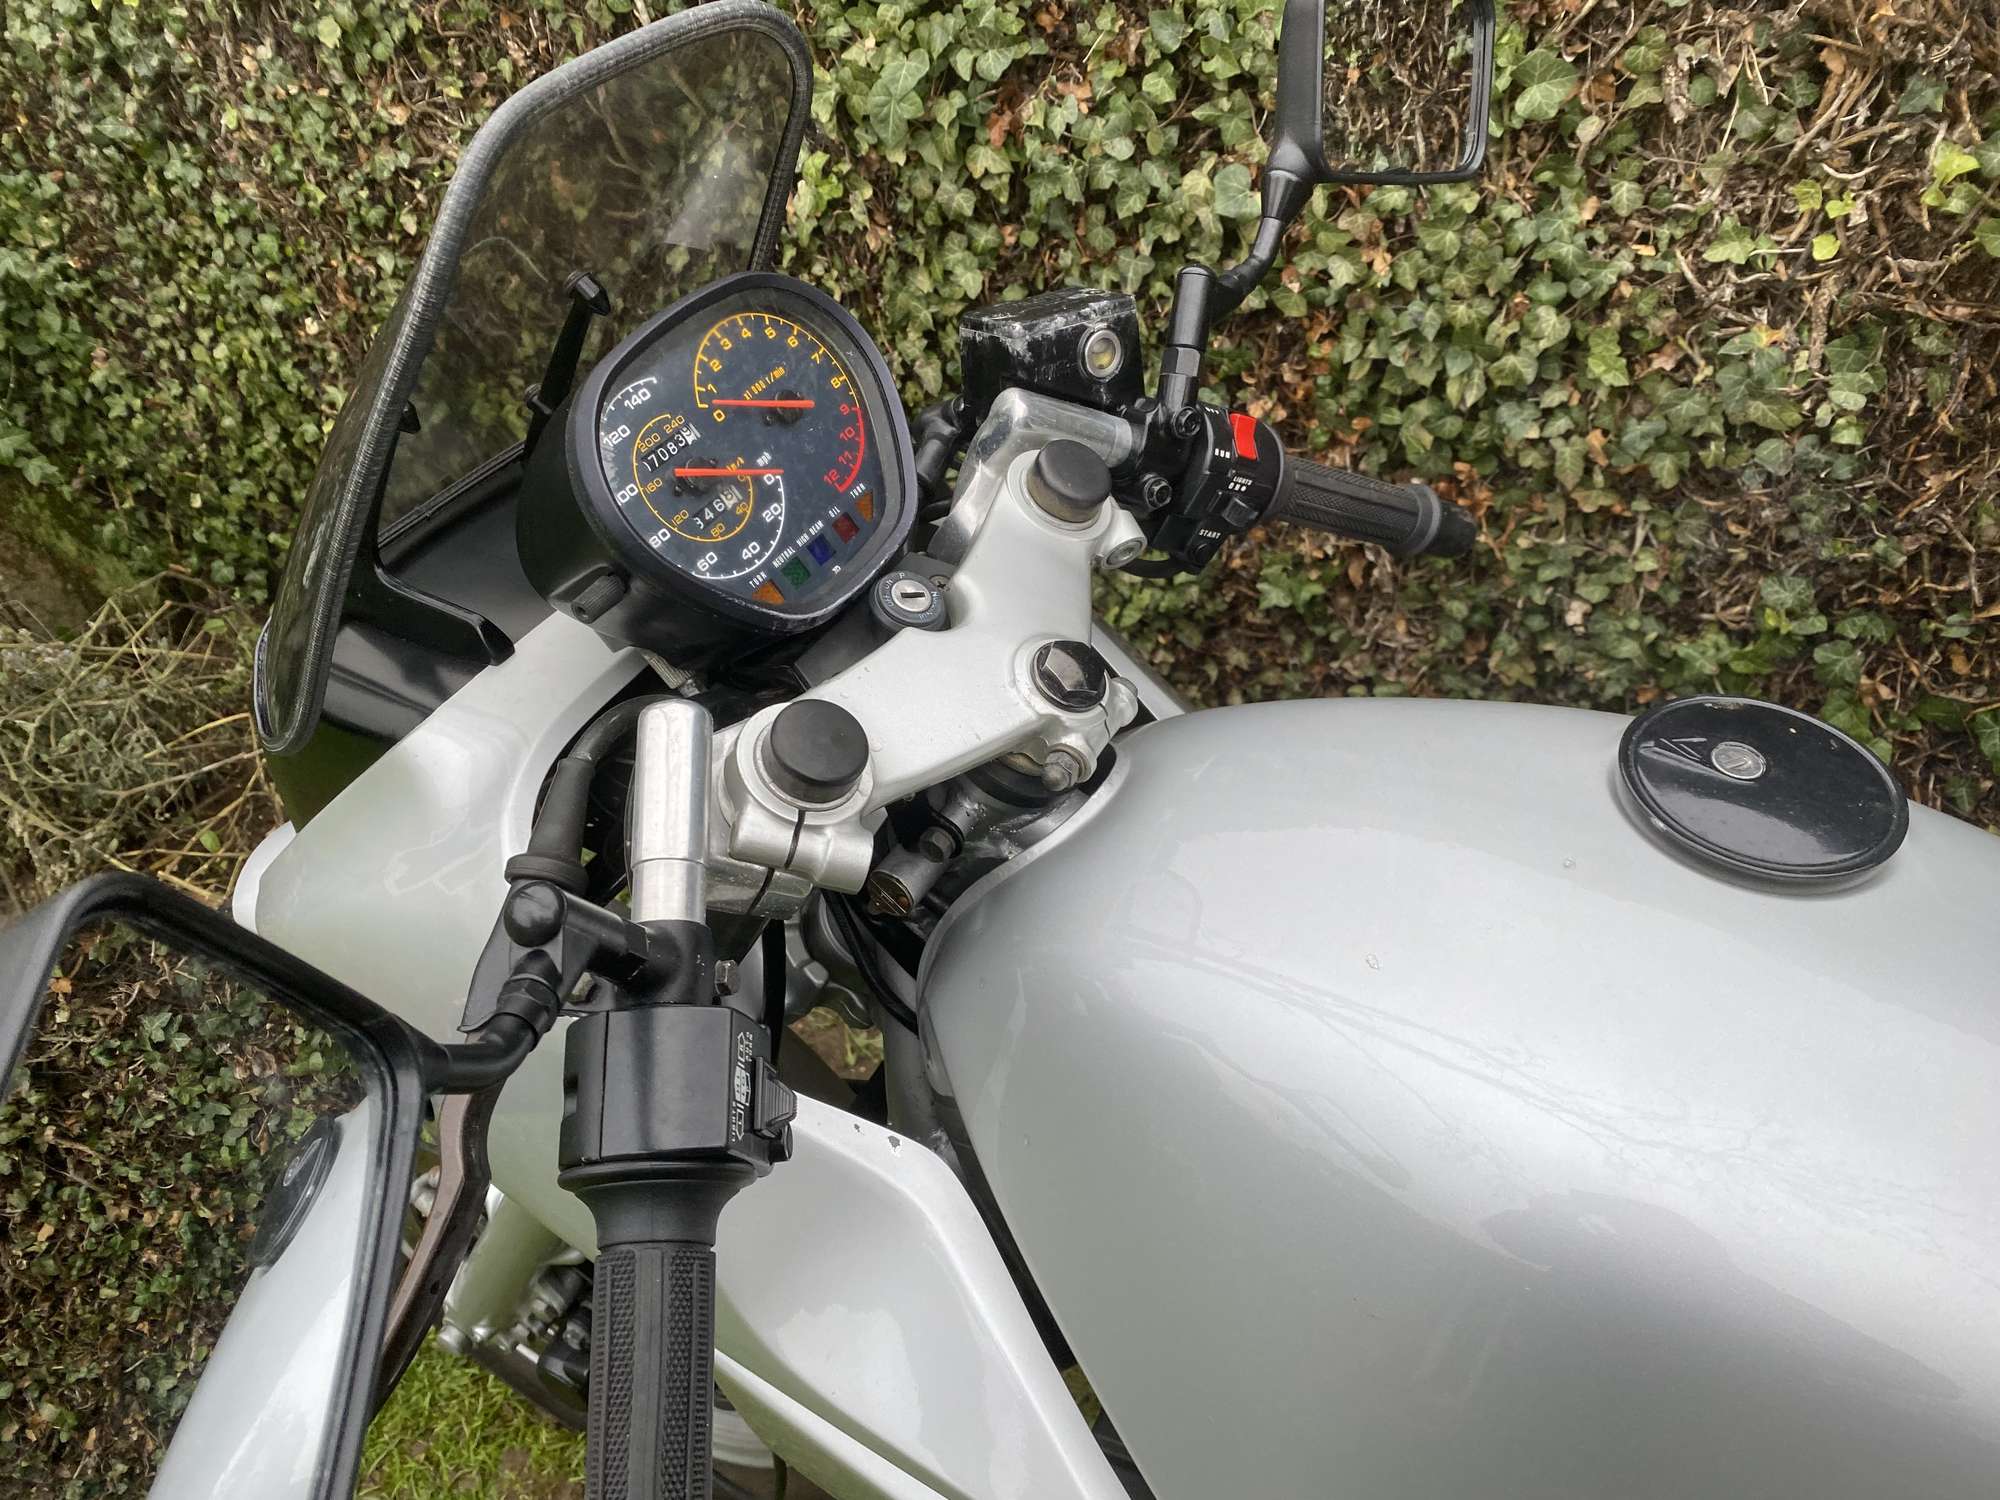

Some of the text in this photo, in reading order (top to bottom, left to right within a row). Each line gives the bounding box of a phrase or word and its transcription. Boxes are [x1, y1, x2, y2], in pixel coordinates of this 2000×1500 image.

[741, 328, 752, 338] 4
[764, 327, 776, 339] 5
[720, 338, 732, 350] 3
[787, 335, 799, 348] 6
[811, 352, 820, 364] 7
[710, 359, 722, 372] 2
[707, 383, 717, 393] 1
[831, 377, 841, 388] 8
[624, 388, 651, 410] 140
[713, 409, 726, 422] 0
[840, 404, 850, 415] 9
[663, 415, 685, 434] 240
[603, 424, 631, 447] 120
[839, 426, 856, 440] 10
[638, 432, 661, 453] 200
[838, 451, 853, 464] 11
[763, 473, 775, 485] 0
[823, 468, 840, 485] 12
[1233, 476, 1253, 486] LIGHTS
[850, 482, 866, 498] TURN
[735, 502, 749, 515] 40
[762, 502, 781, 522] 20
[828, 505, 841, 518] OIL
[671, 509, 689, 526] 120
[710, 522, 725, 537] 80
[1199, 529, 1221, 539] START
[648, 528, 671, 548] 80
[742, 541, 760, 560] 40
[771, 546, 796, 568] NEUTRAL
[696, 551, 718, 571] 60
[748, 571, 767, 588] TURN
